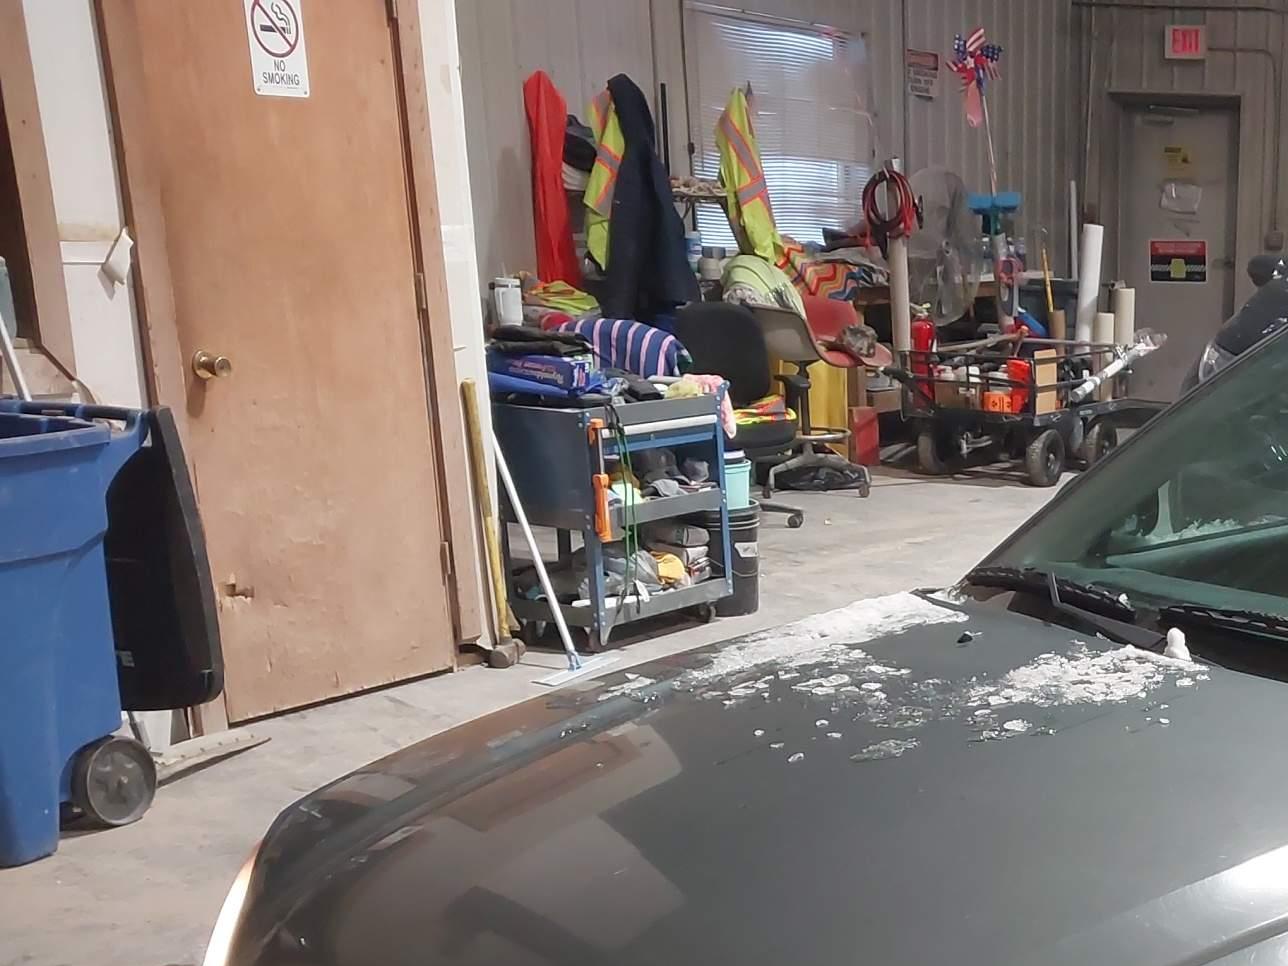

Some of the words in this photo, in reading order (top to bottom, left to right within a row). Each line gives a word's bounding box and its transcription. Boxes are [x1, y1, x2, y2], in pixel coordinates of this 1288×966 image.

[1172, 28, 1199, 54] EXIT
[273, 59, 286, 72] NO
[262, 71, 300, 86] SMOKING
